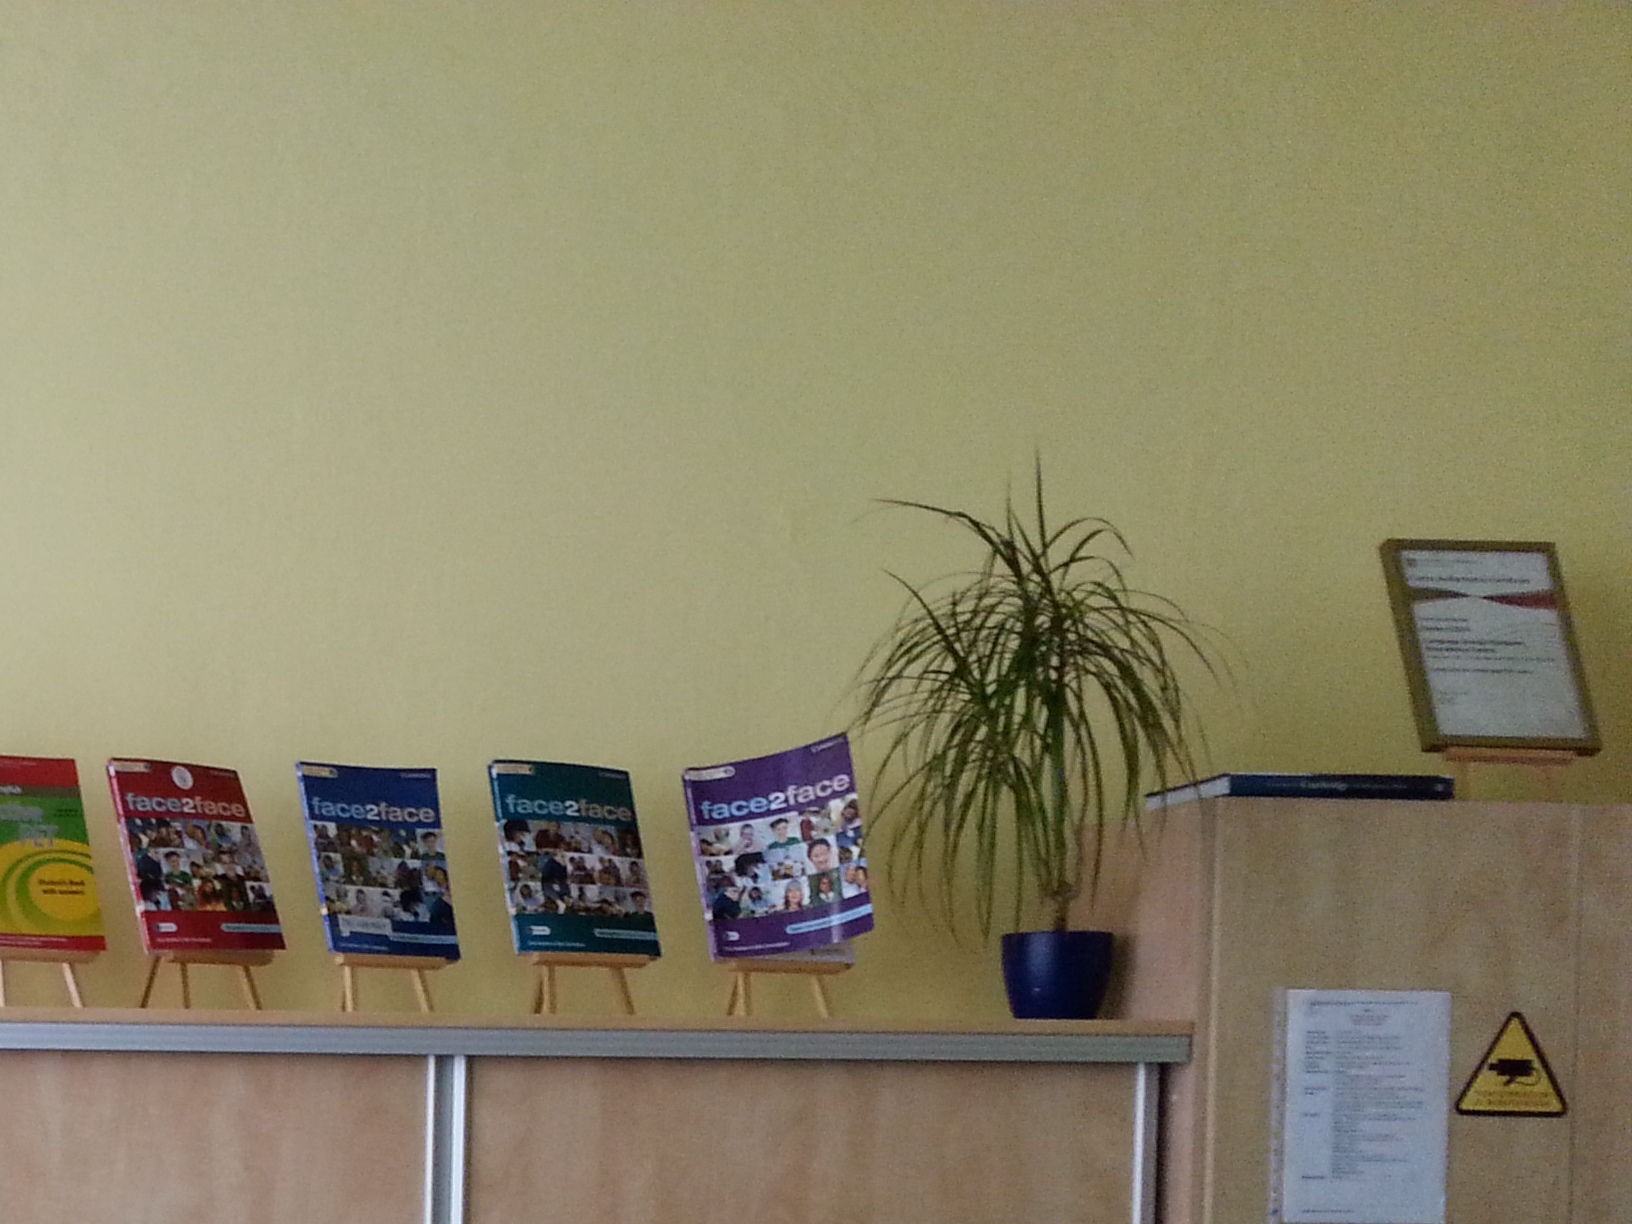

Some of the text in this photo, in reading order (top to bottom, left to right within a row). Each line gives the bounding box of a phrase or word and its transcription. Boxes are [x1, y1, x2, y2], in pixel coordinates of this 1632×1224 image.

[124, 792, 247, 818] face2face
[311, 796, 436, 823] face2face
[504, 793, 633, 822] face2face
[700, 773, 851, 820] face2face
[18, 824, 60, 847] PET
